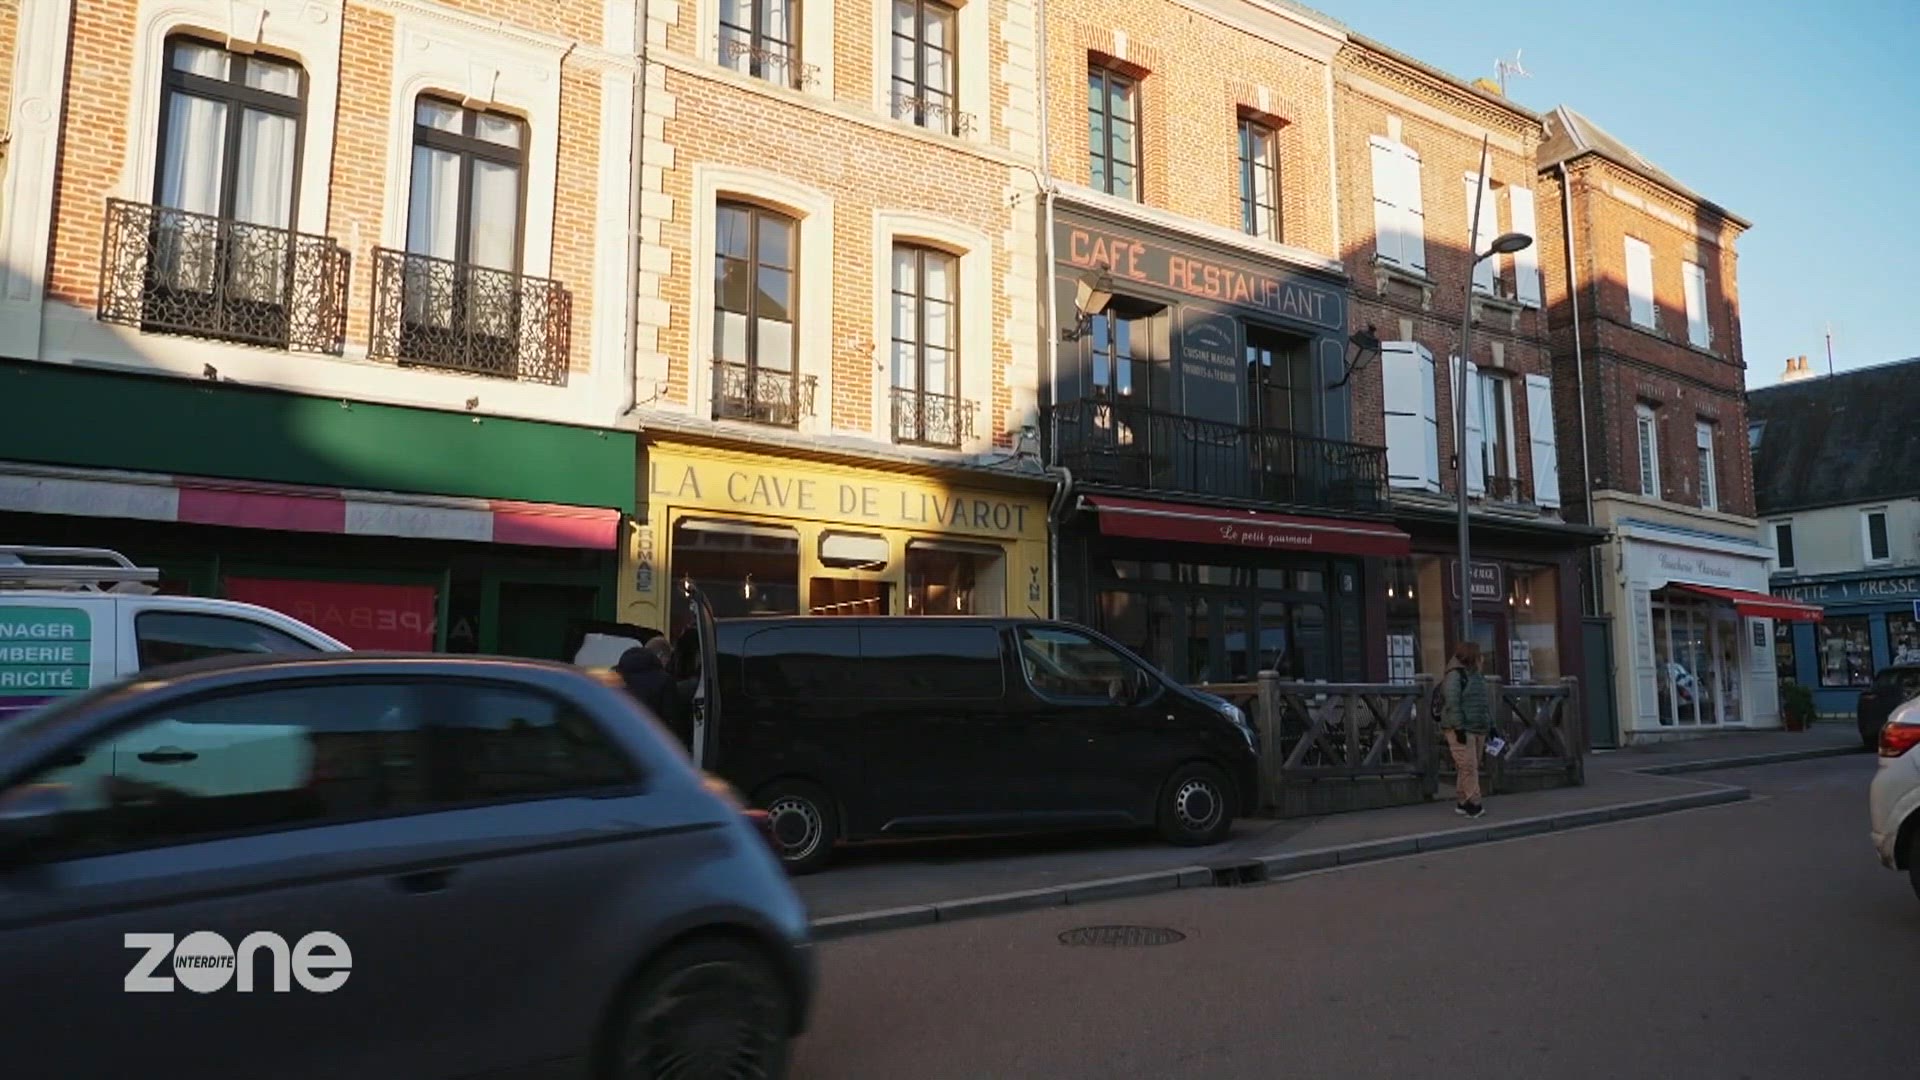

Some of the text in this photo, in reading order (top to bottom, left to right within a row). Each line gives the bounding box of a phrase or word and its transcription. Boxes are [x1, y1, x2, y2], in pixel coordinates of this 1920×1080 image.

[1070, 230, 1326, 320] CAFÉ RESTAURANT
[650, 461, 1029, 533] LA CAVE DE LIVAROT
[1220, 525, 1238, 540] Le
[1241, 532, 1263, 544] petit
[1860, 578, 1918, 596] PRESSE
[0, 623, 75, 638] NAGER
[1, 669, 74, 686] RICITÉ
